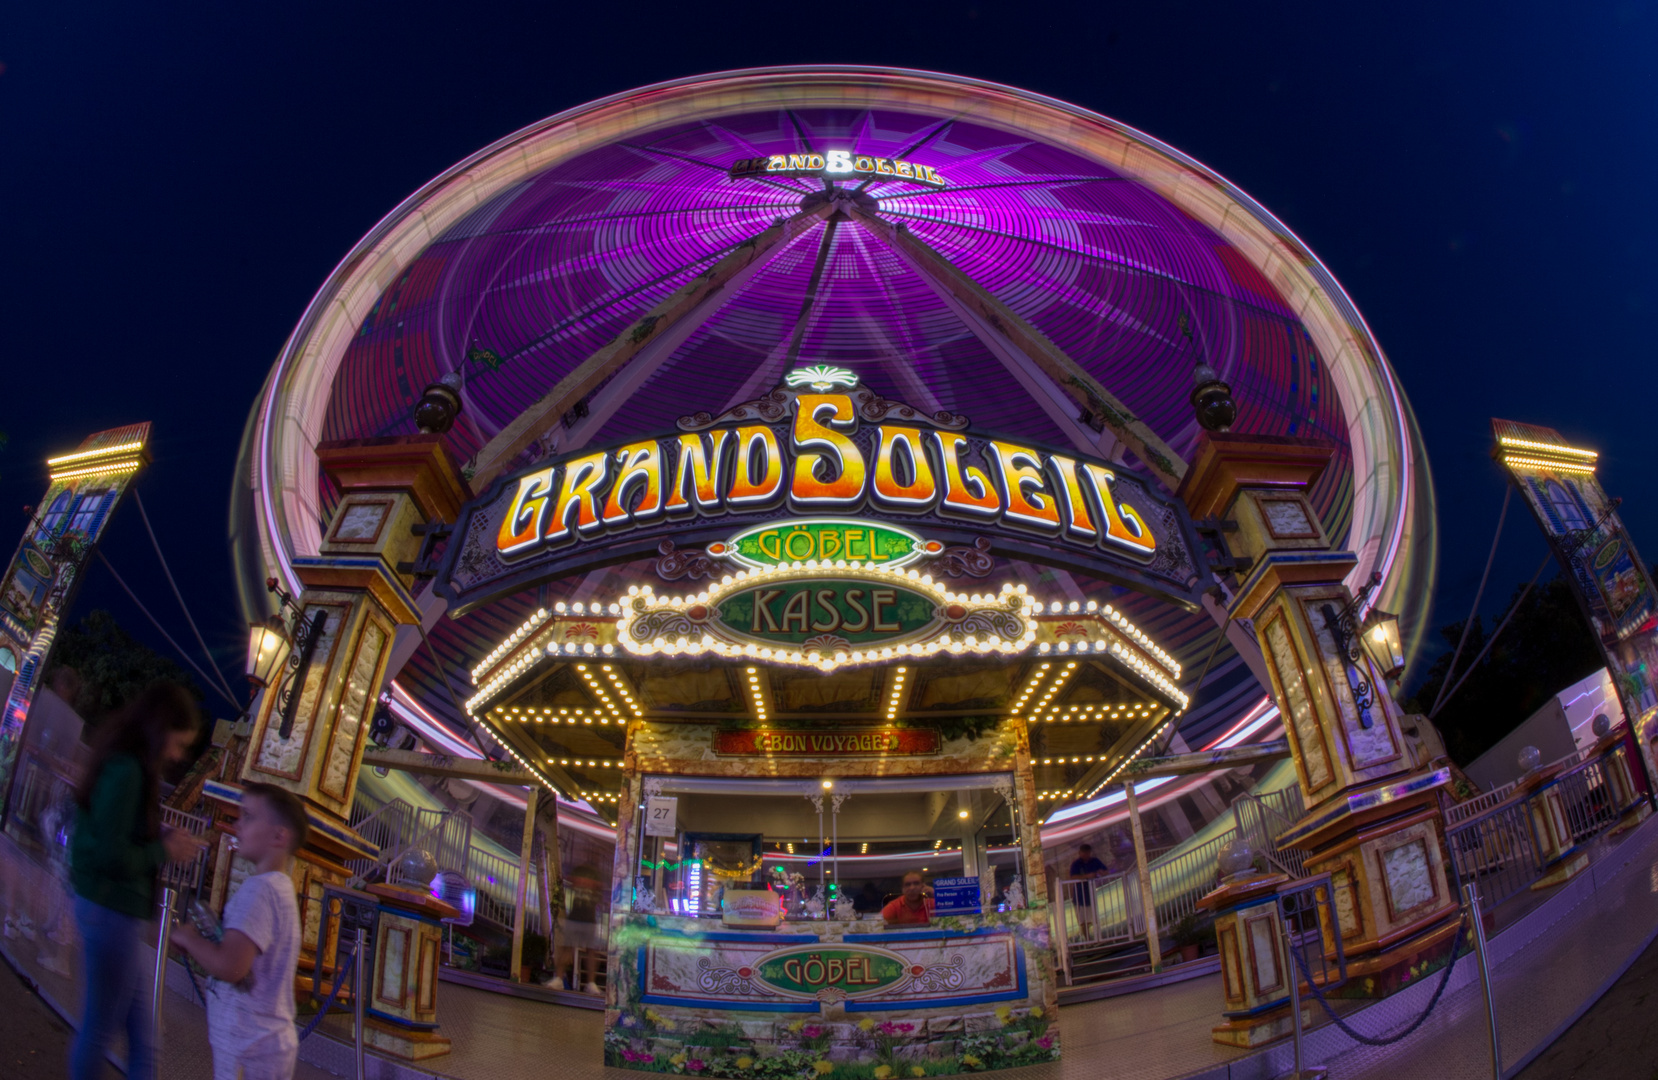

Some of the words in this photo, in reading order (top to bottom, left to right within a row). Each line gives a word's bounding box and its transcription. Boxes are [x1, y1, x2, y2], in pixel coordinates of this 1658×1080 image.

[730, 154, 825, 176] GRAND
[826, 150, 945, 186] SOLEIL
[497, 424, 784, 554] GRAND
[790, 393, 1156, 554] SOLEIL
[758, 525, 890, 560] GÖBEL
[752, 589, 902, 633] KASSE
[770, 735, 807, 751] BON
[810, 734, 883, 751] VOYAGE
[653, 807, 670, 819] 27
[935, 879, 957, 887] GRAND
[783, 954, 880, 985] GÖBEL
